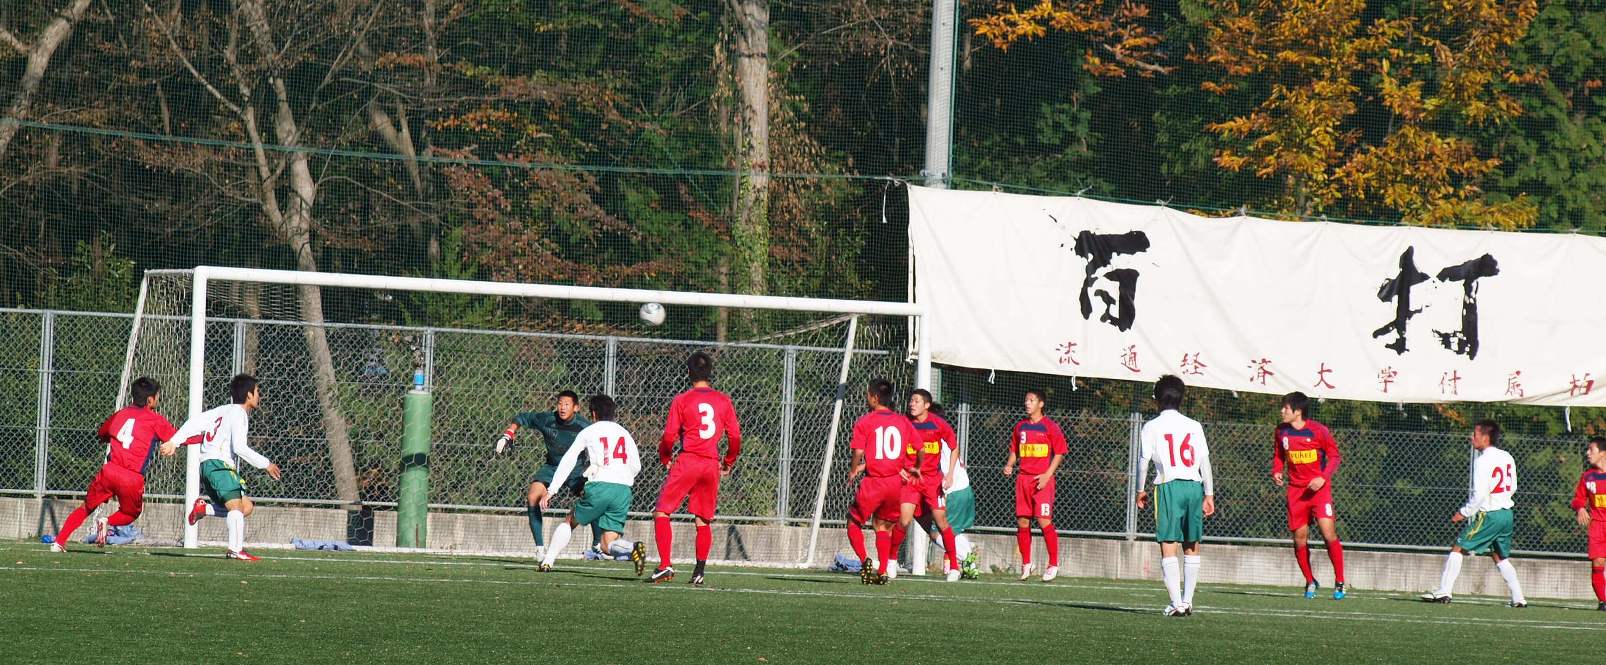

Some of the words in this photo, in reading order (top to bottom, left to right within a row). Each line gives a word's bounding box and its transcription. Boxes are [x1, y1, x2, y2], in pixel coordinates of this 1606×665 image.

[117, 418, 136, 449] 4
[205, 416, 223, 443] 3
[697, 402, 717, 440] 3
[599, 436, 628, 466] 14
[874, 425, 902, 460] 10
[1163, 433, 1195, 468] 16
[1489, 463, 1512, 494] 25
